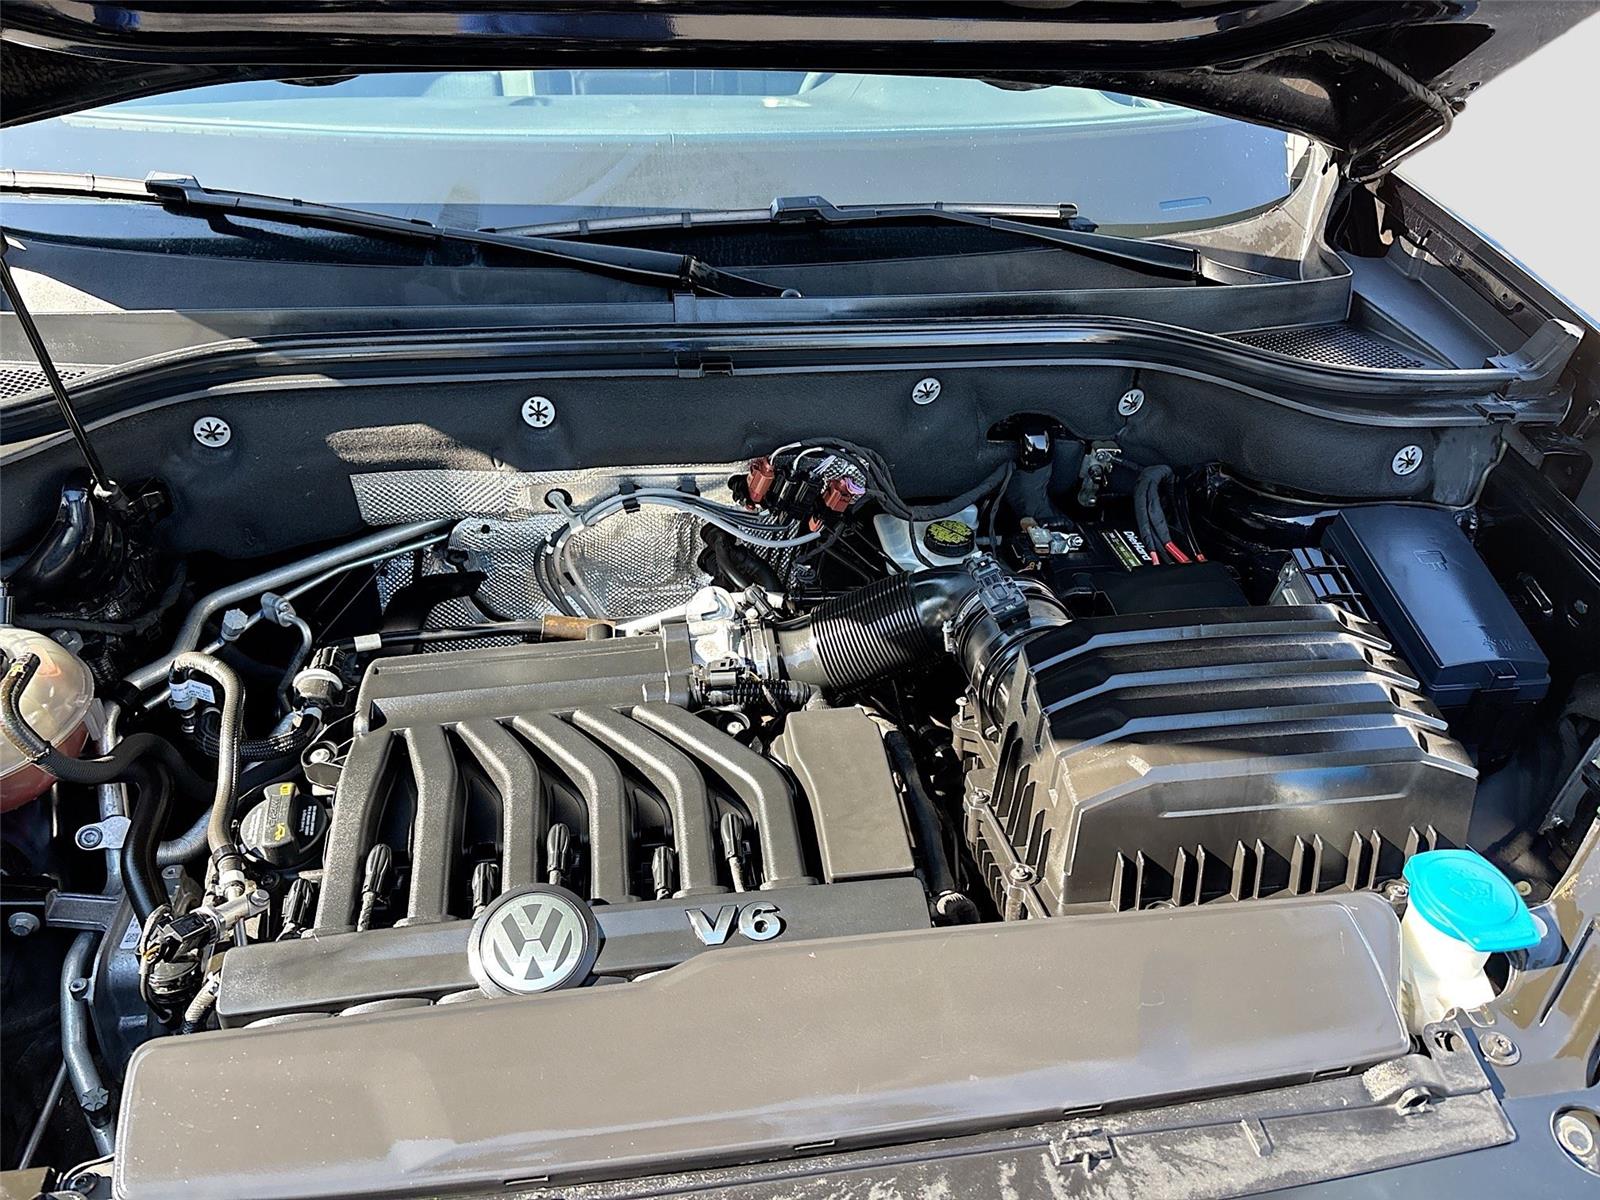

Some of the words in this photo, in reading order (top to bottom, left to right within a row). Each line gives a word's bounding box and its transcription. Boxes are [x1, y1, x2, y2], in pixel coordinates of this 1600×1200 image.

[1123, 530, 1153, 561] DieHard
[481, 892, 584, 992] VW
[685, 901, 782, 946] V6
